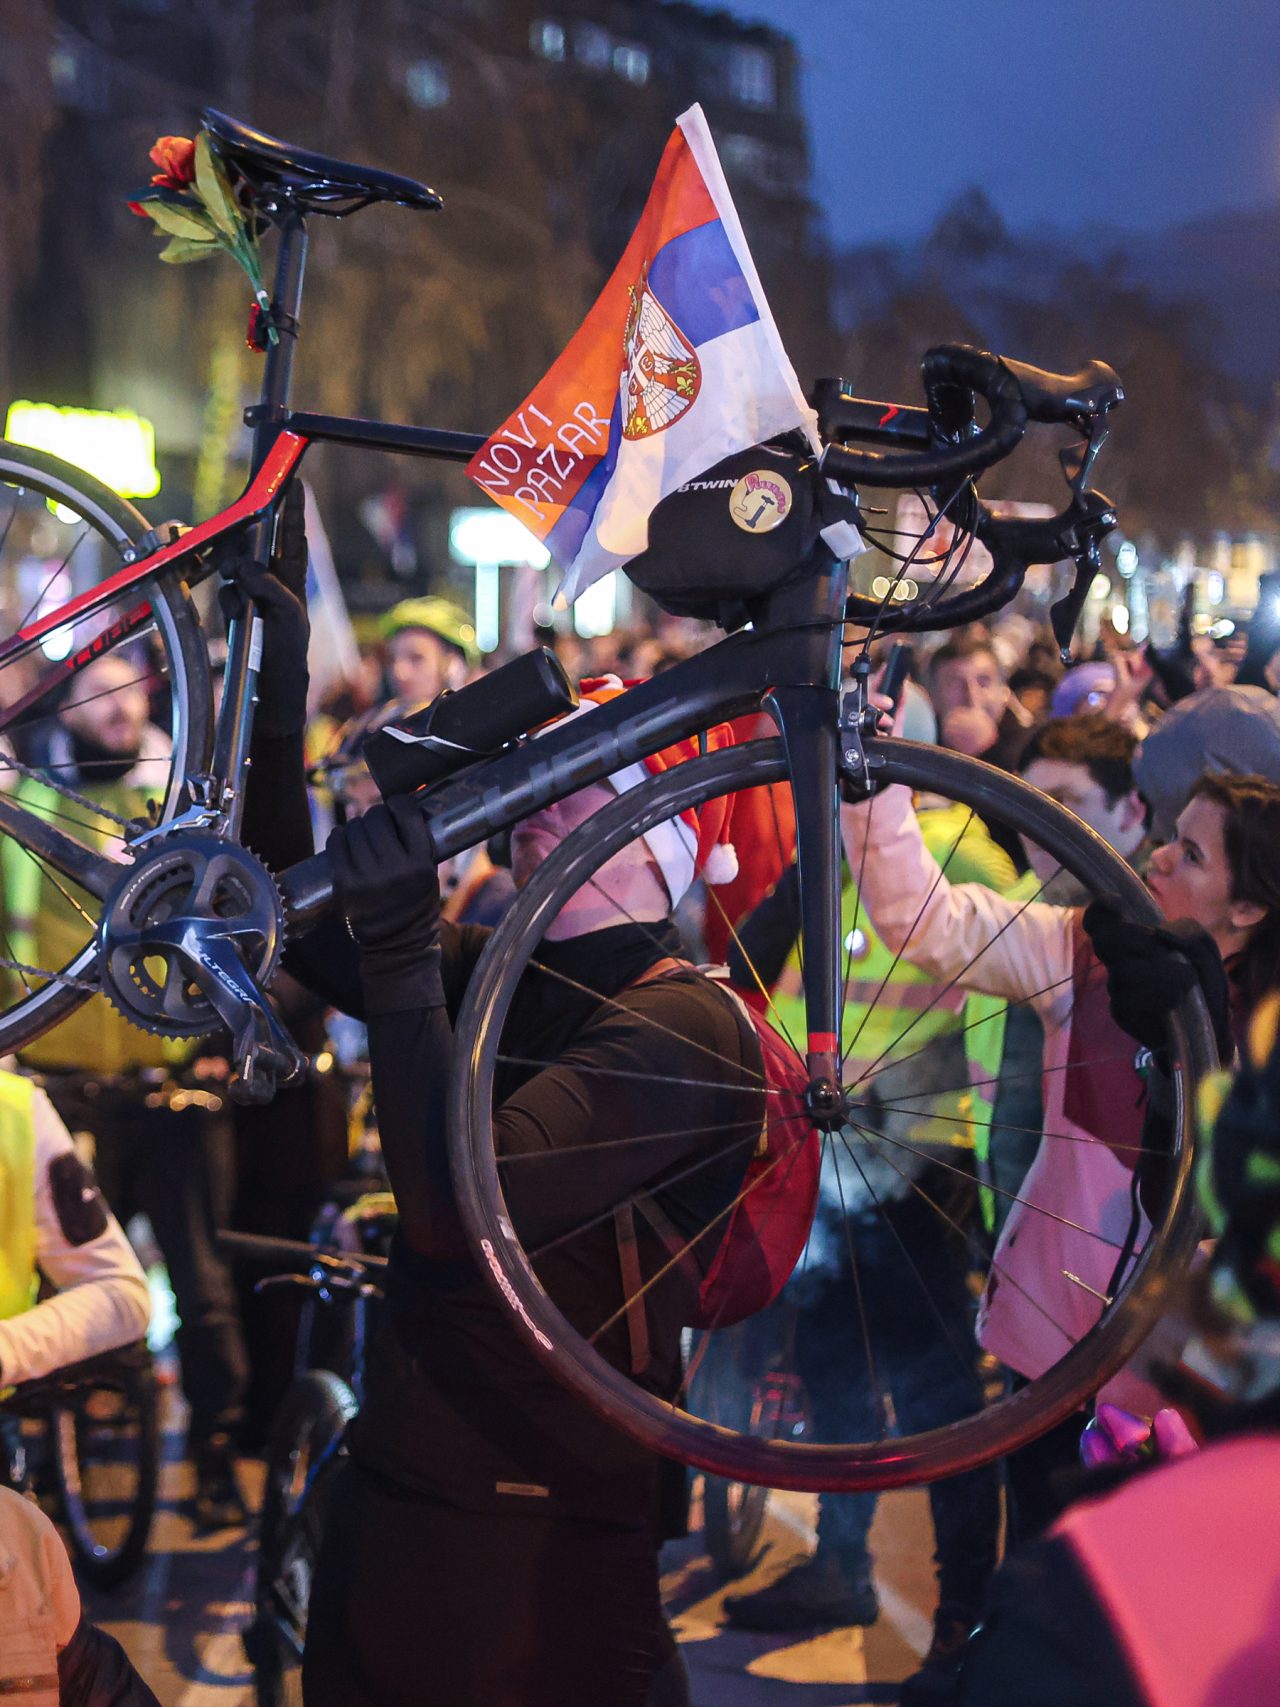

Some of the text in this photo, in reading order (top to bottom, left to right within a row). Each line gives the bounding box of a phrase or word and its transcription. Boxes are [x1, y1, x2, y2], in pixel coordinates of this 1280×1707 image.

[473, 404, 553, 497] NOVI
[514, 401, 611, 521] PAZAR
[429, 697, 682, 853] CUBE
